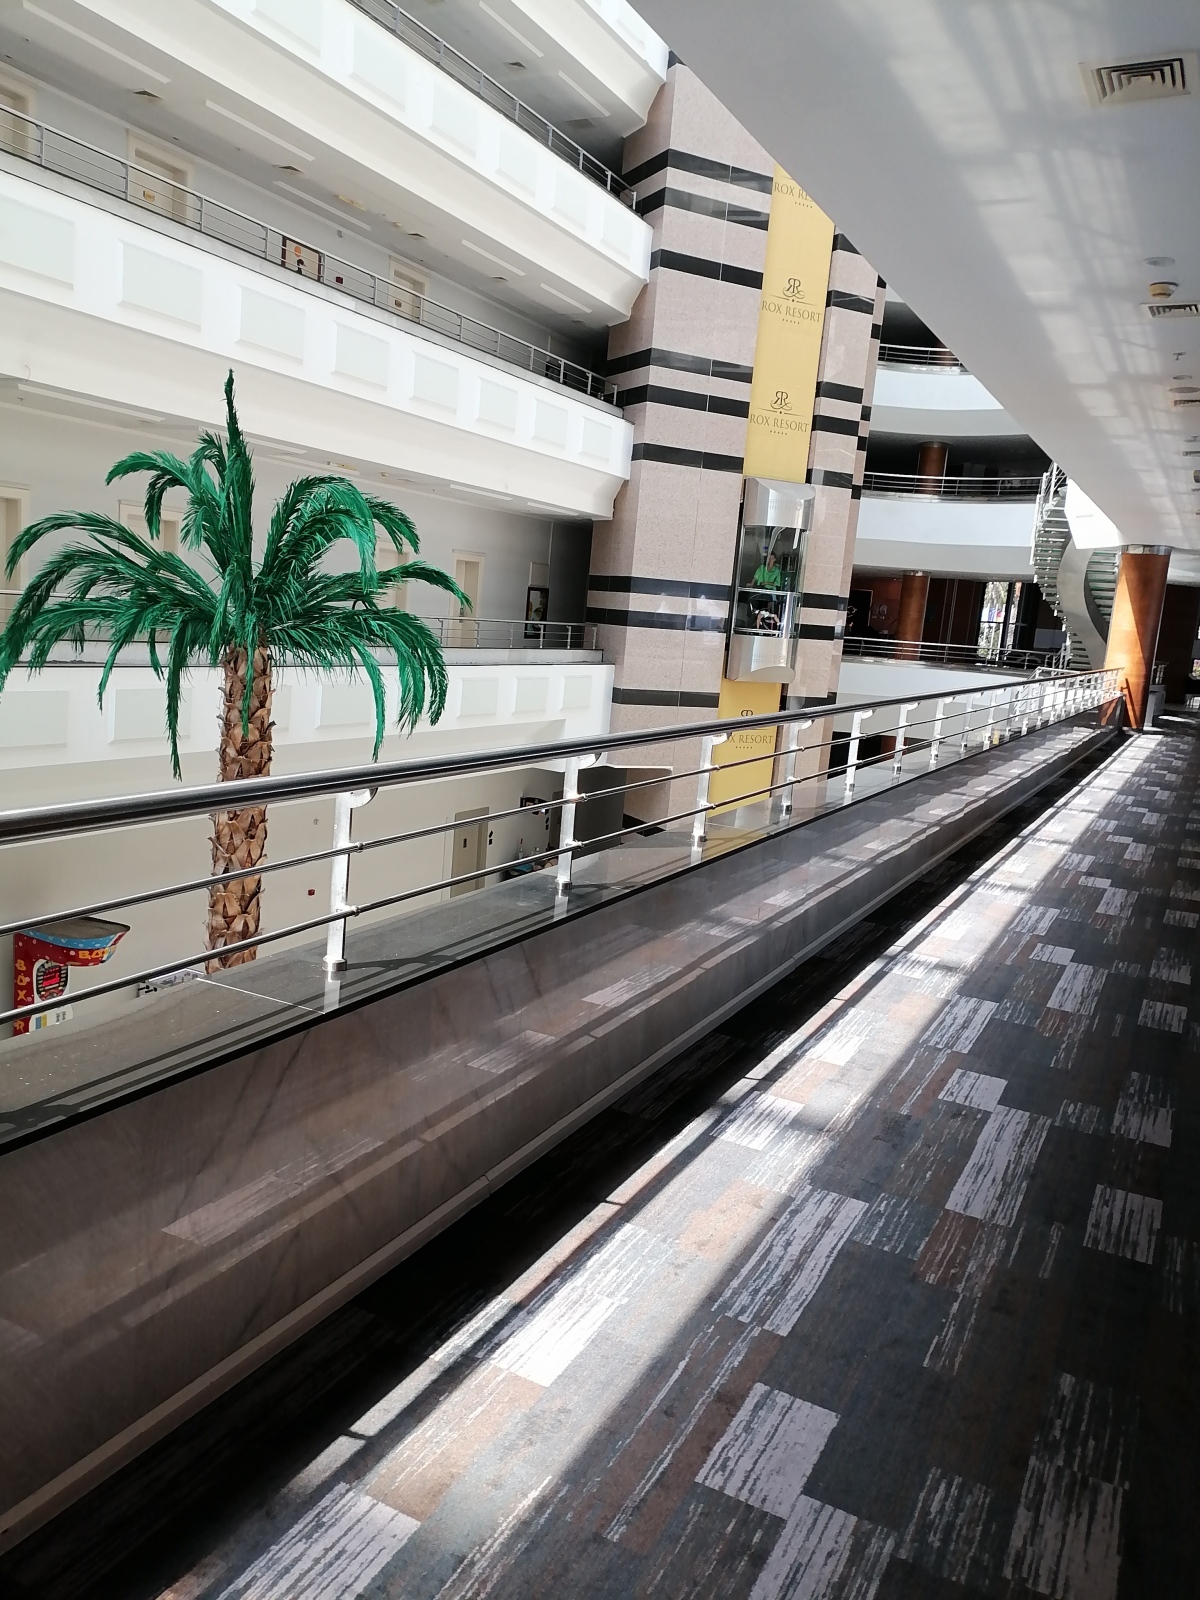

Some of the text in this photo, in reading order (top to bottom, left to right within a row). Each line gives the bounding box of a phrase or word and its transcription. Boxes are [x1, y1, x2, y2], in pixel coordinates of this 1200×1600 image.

[774, 181, 795, 197] ROX
[762, 300, 823, 323] ROX RESORT
[749, 413, 810, 433] ROX RESORT
[738, 734, 774, 744] RESORT
[16, 959, 28, 1033] BOXR
